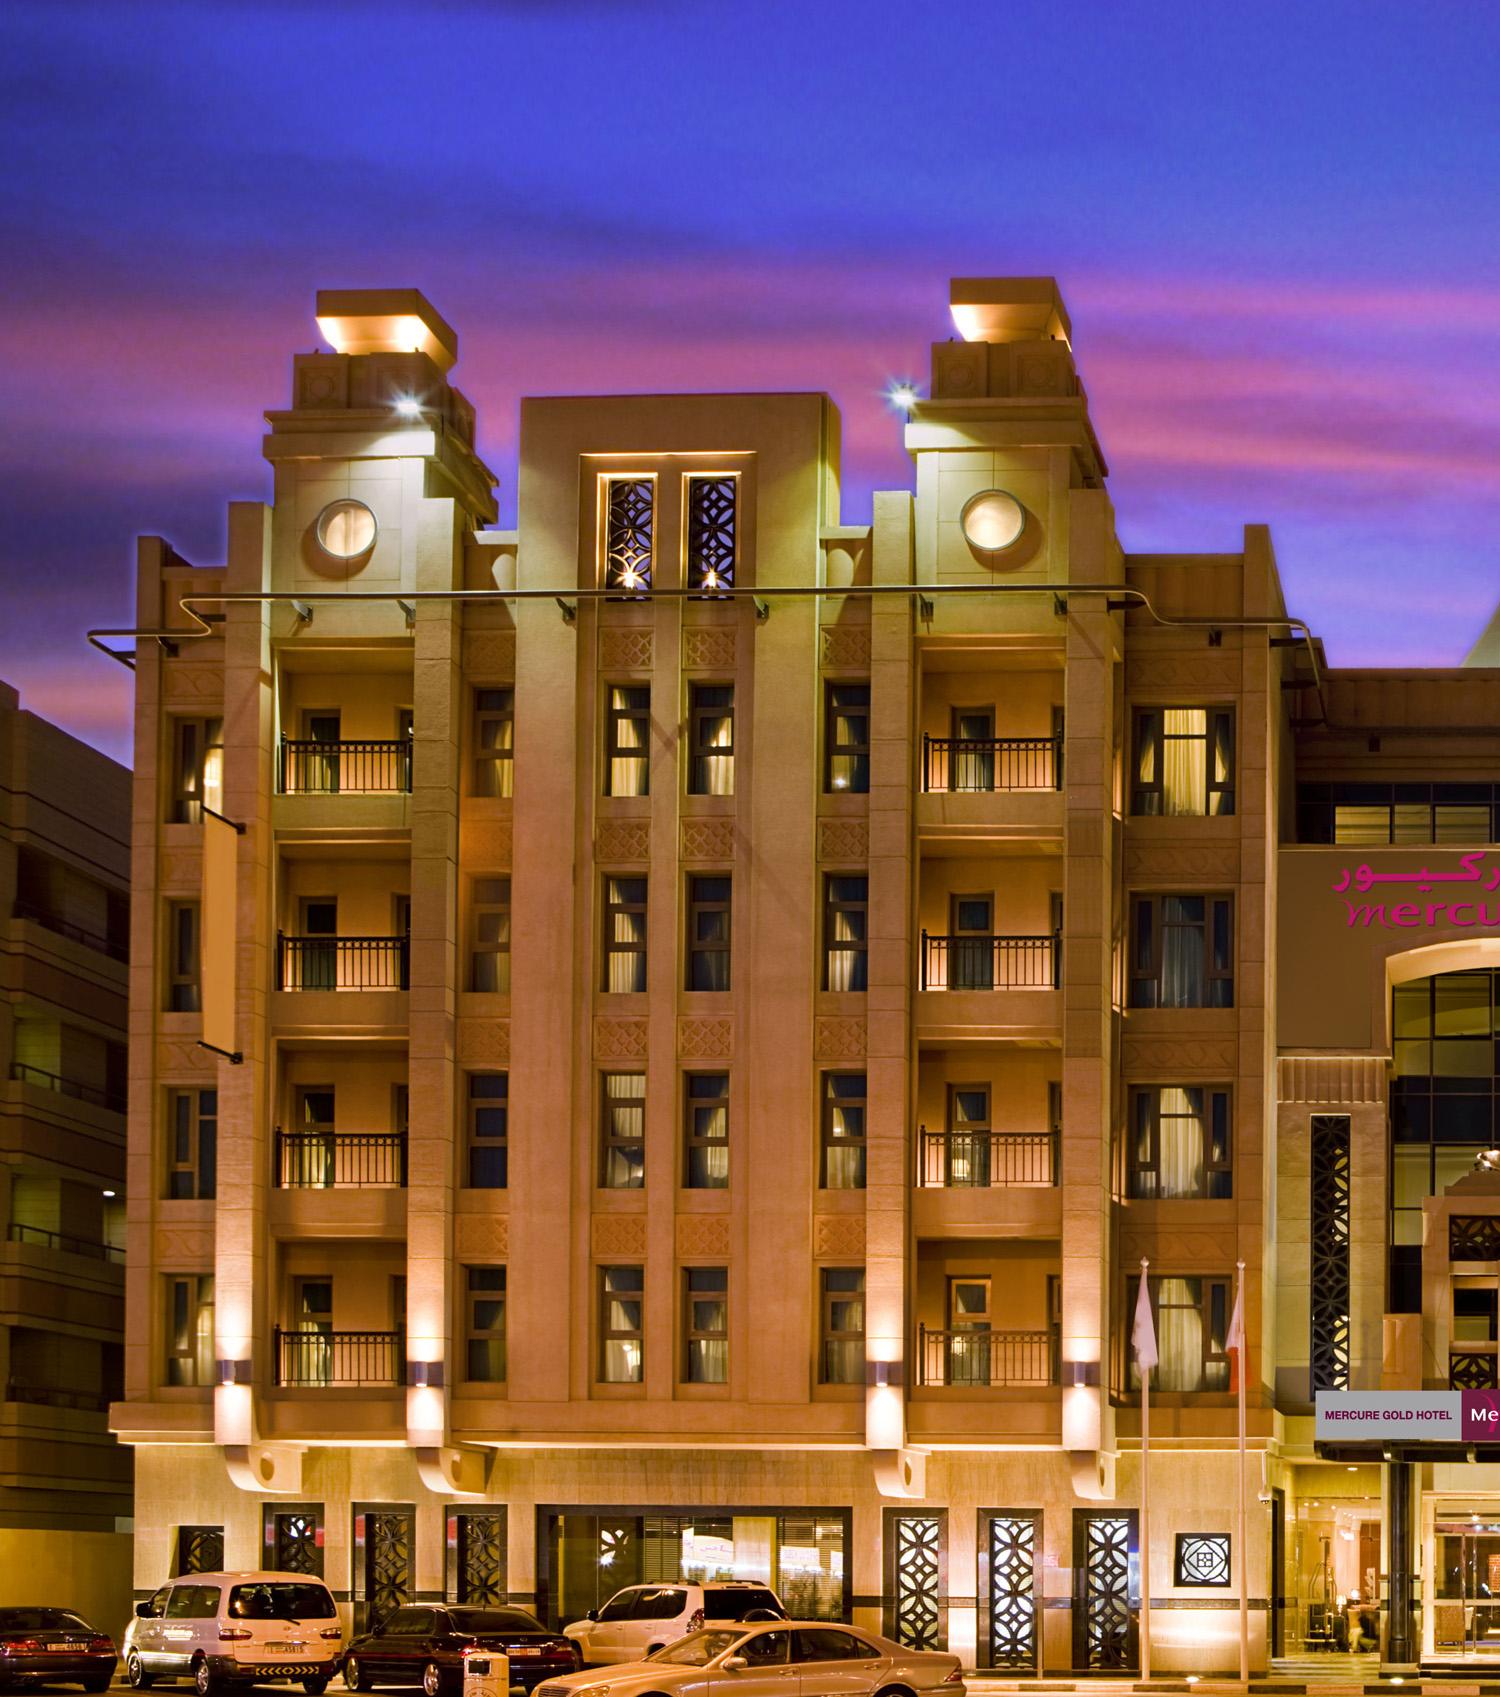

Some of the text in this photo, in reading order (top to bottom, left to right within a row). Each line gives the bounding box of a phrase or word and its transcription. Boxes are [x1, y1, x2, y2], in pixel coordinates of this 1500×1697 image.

[1325, 1410, 1453, 1421] MERCURE GOLD HOTEL
